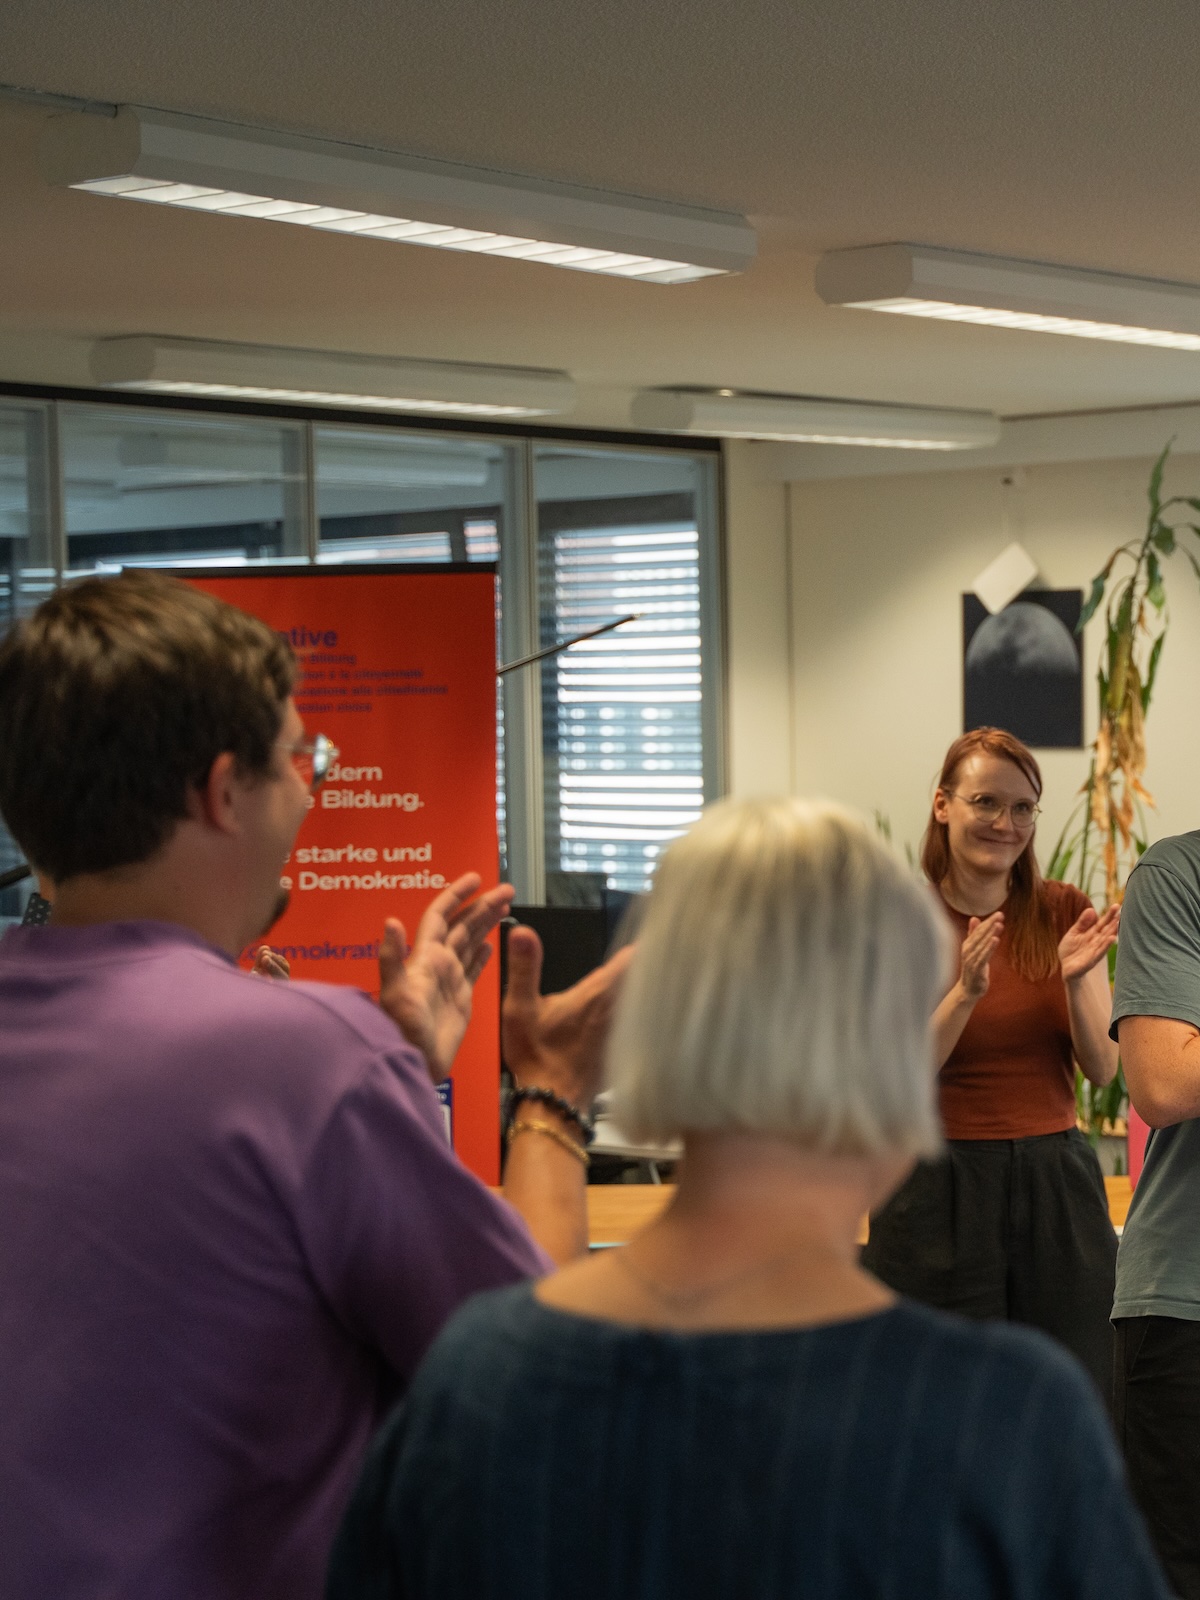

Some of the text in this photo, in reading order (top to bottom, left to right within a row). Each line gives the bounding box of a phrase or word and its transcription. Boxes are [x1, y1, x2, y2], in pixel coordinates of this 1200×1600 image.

[325, 763, 383, 782] dern
[321, 789, 425, 812] Bildung.
[296, 844, 378, 863] starke
[383, 842, 432, 862] und
[299, 869, 451, 890] Demokratie.
